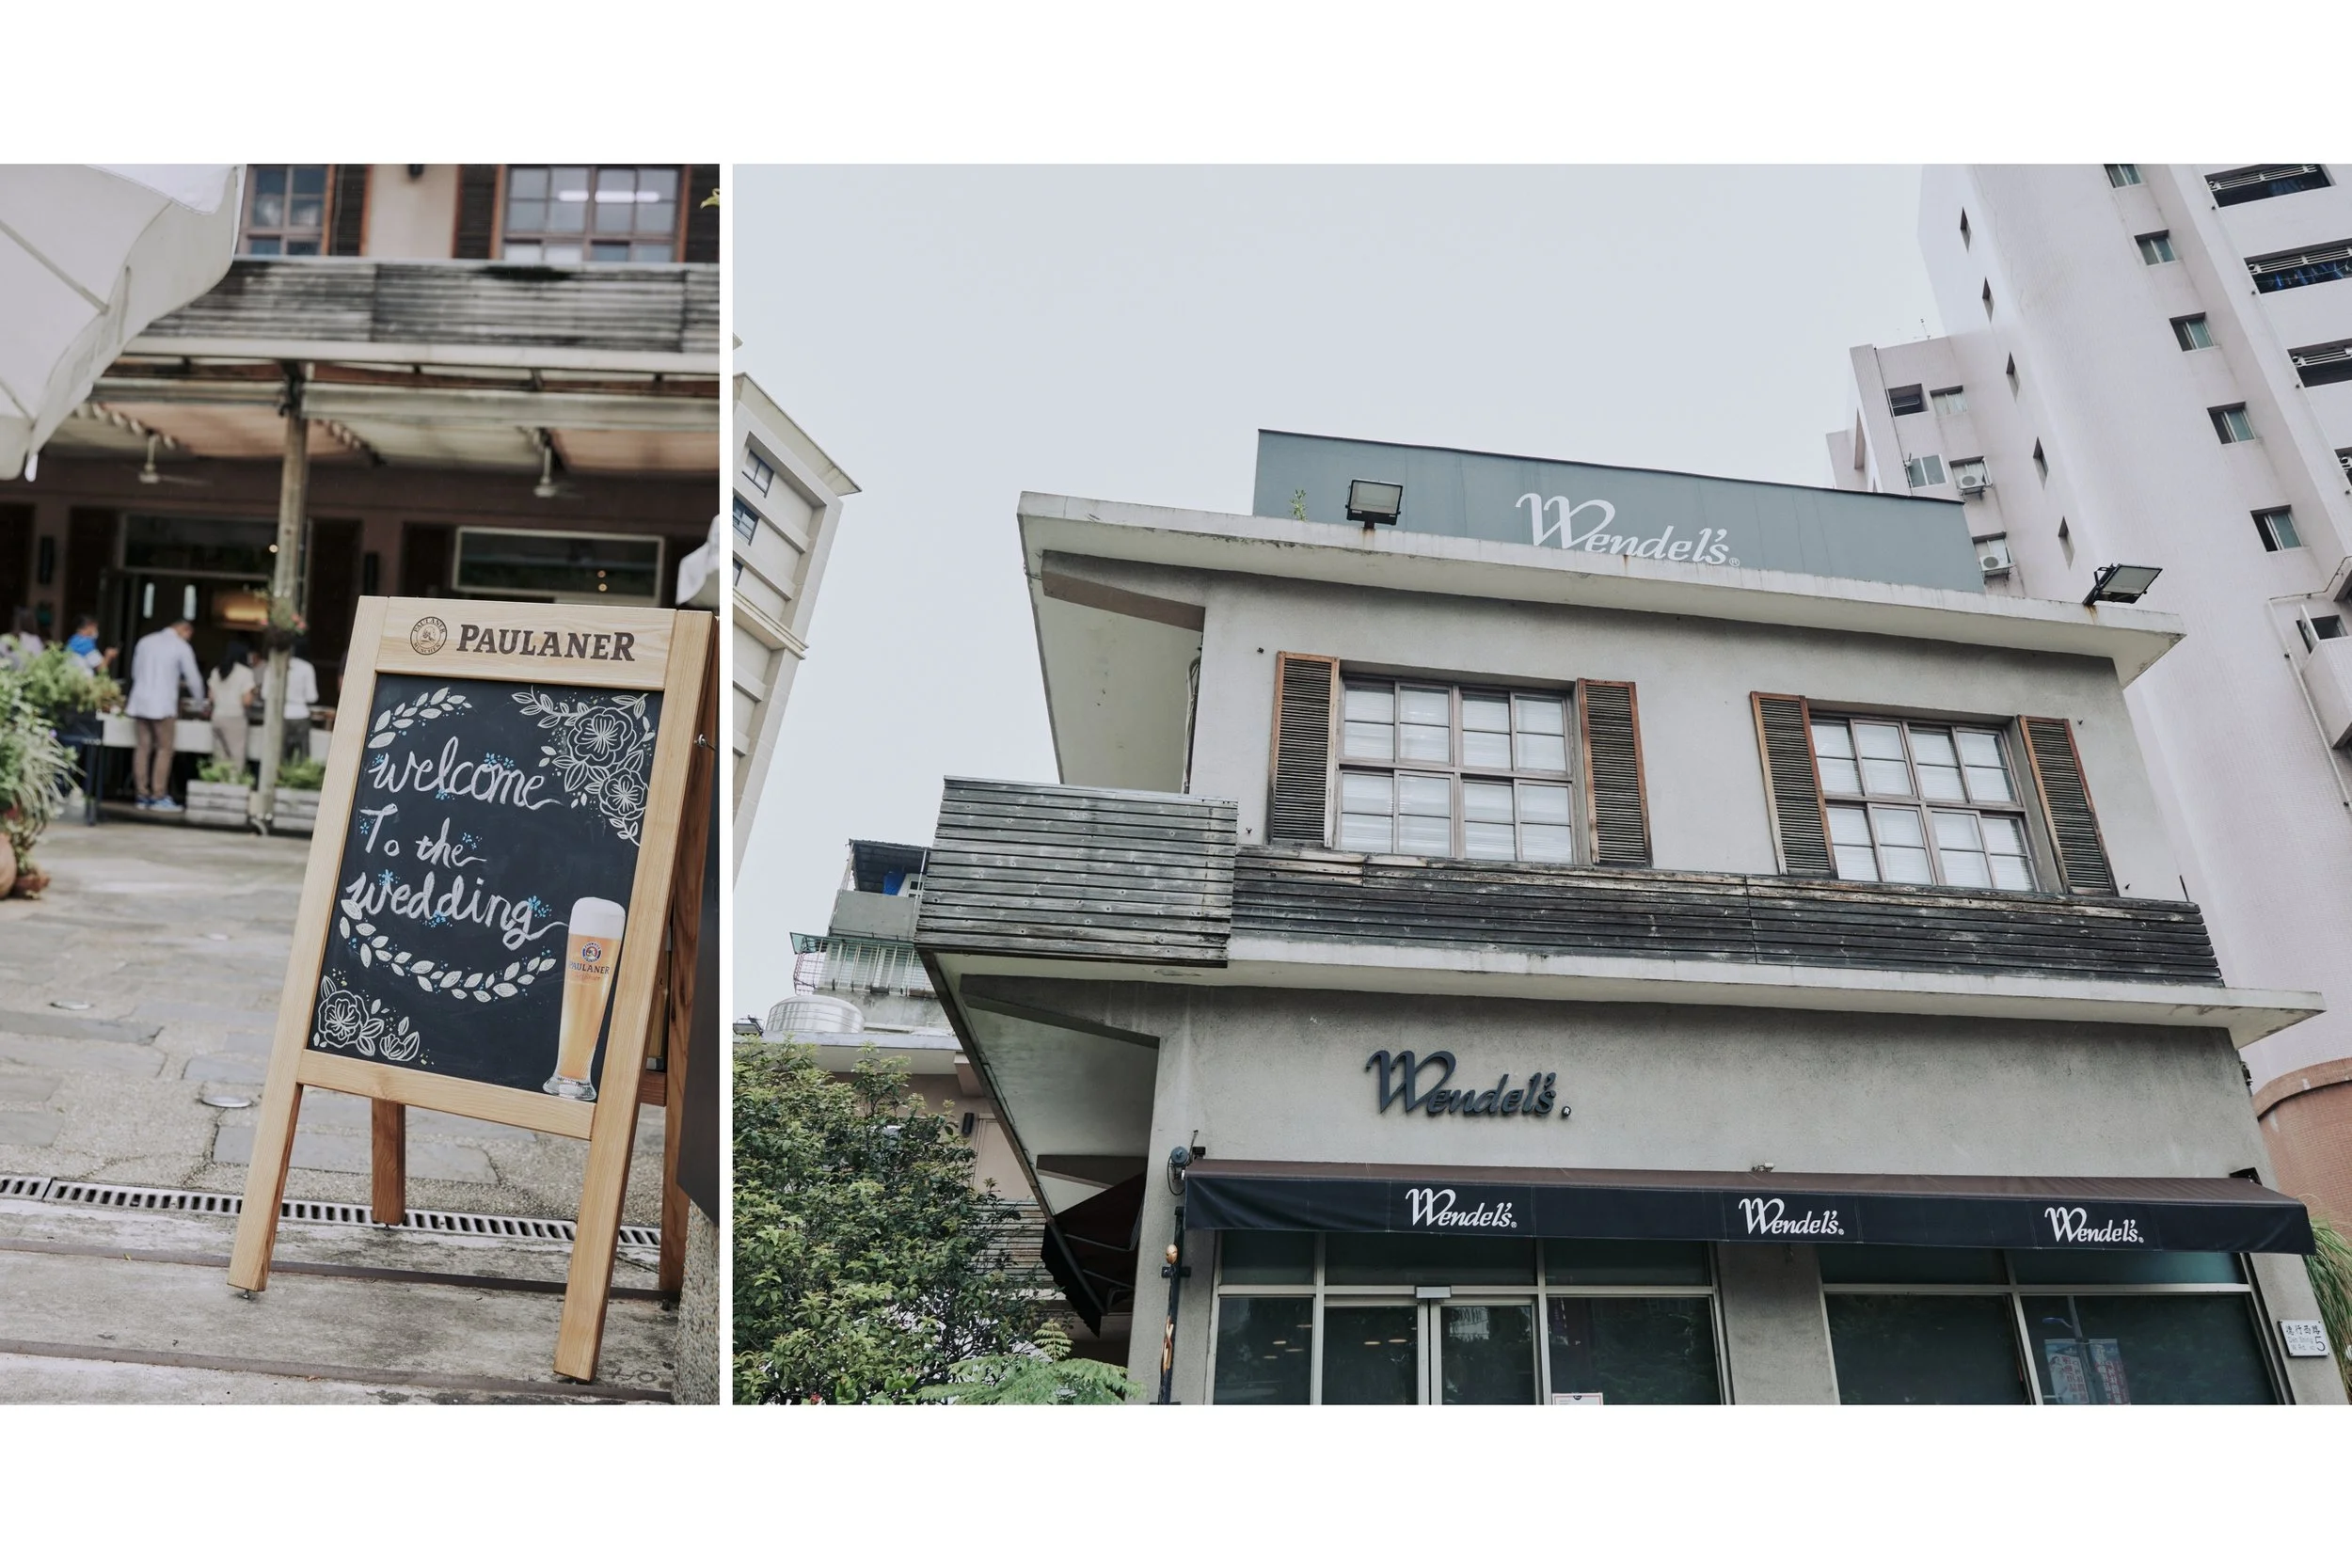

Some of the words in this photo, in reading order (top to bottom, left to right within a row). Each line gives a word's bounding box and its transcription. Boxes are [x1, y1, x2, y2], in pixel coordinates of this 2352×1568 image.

[1515, 493, 1730, 564] Wendel's
[456, 624, 636, 661] PAULANER
[359, 802, 401, 854] To
[415, 816, 487, 869] the
[569, 962, 611, 974] PAULANER
[1366, 1050, 1558, 1115] Wendel's
[1405, 1187, 1514, 1227] Wendel's
[1738, 1197, 1839, 1235] Wendel's
[2044, 1206, 2138, 1243] Wendel's
[2314, 1336, 2327, 1352] 5
